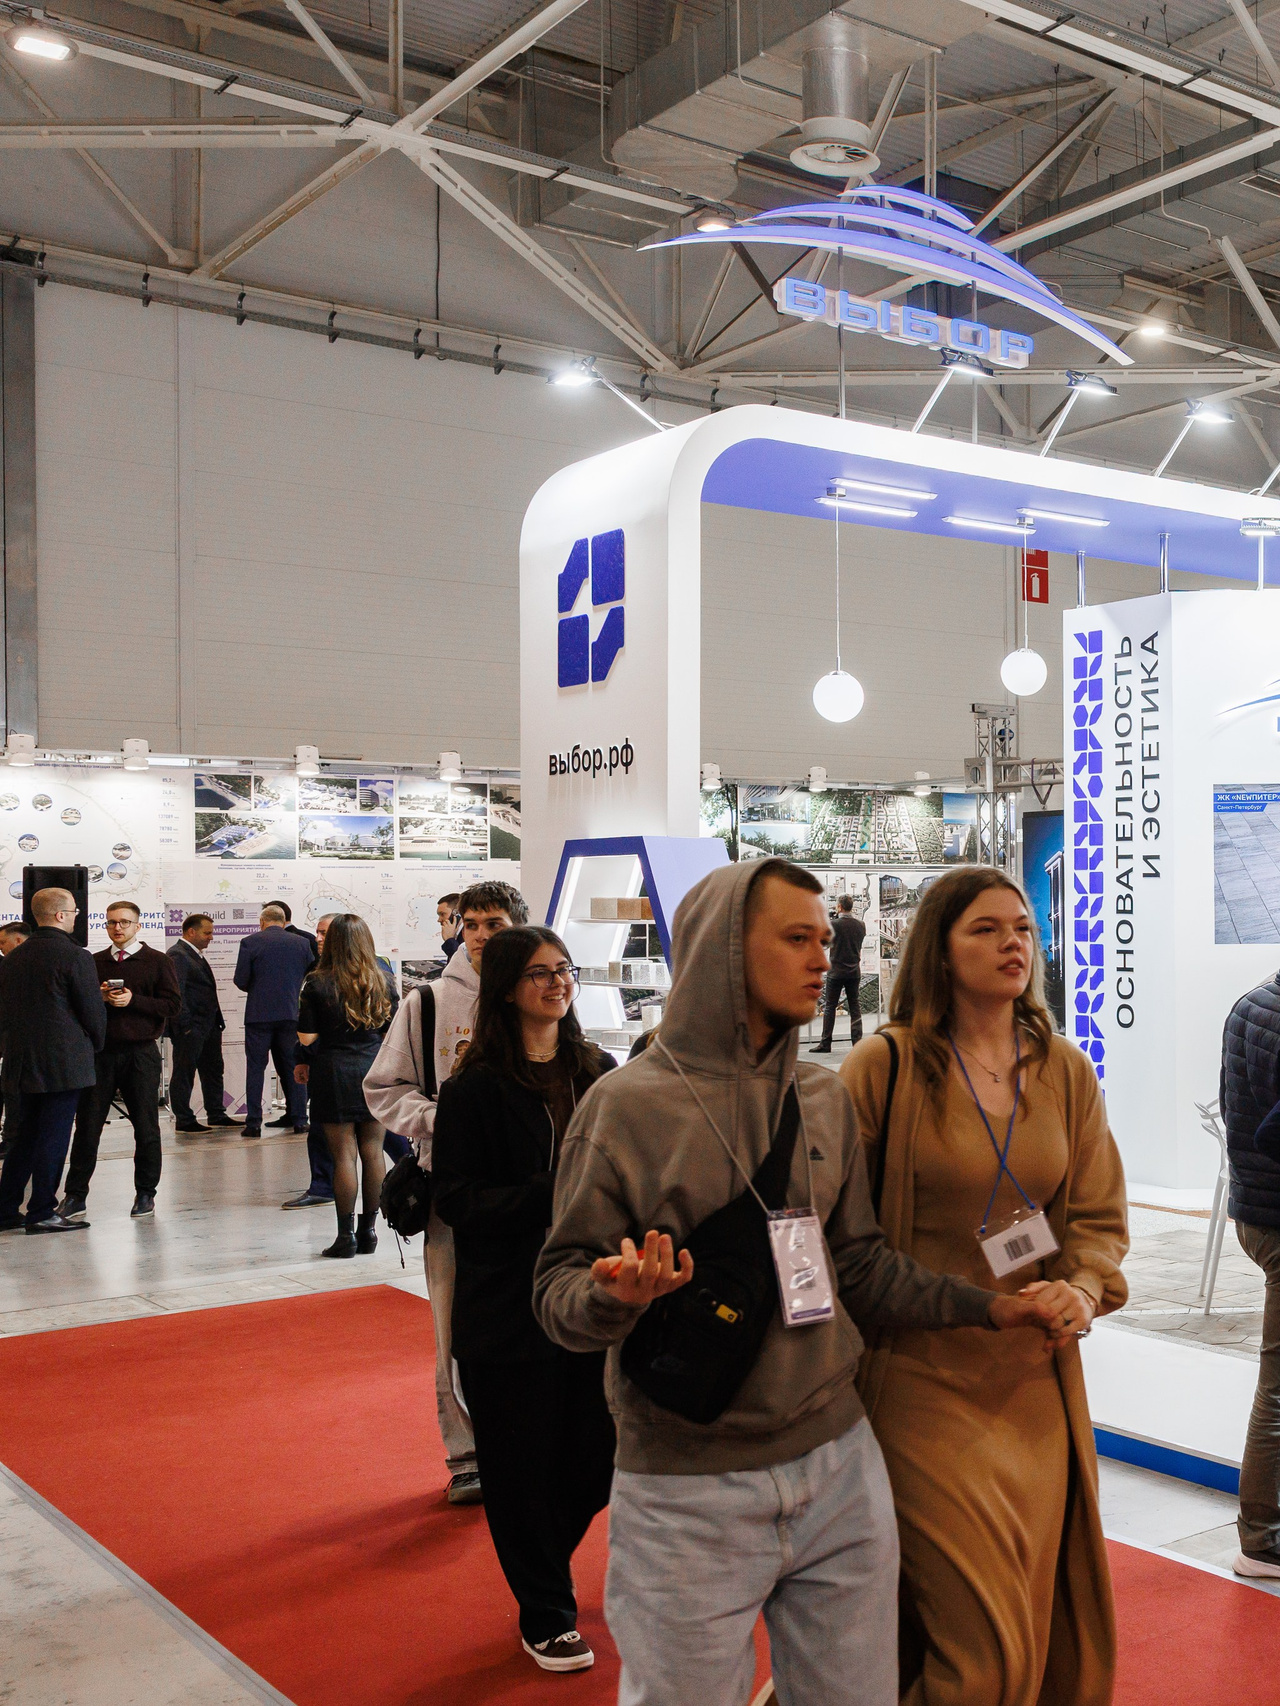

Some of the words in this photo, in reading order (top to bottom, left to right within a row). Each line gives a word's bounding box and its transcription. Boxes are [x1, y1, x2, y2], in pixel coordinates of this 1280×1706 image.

[782, 277, 1035, 362] ВЫБОР
[548, 737, 634, 779] выбор.рф
[1140, 630, 1161, 841] ЭСТЕТИКА
[1114, 636, 1134, 1029] ОСНОВАТЕЛЬНОСТЬ
[1142, 854, 1161, 879] И
